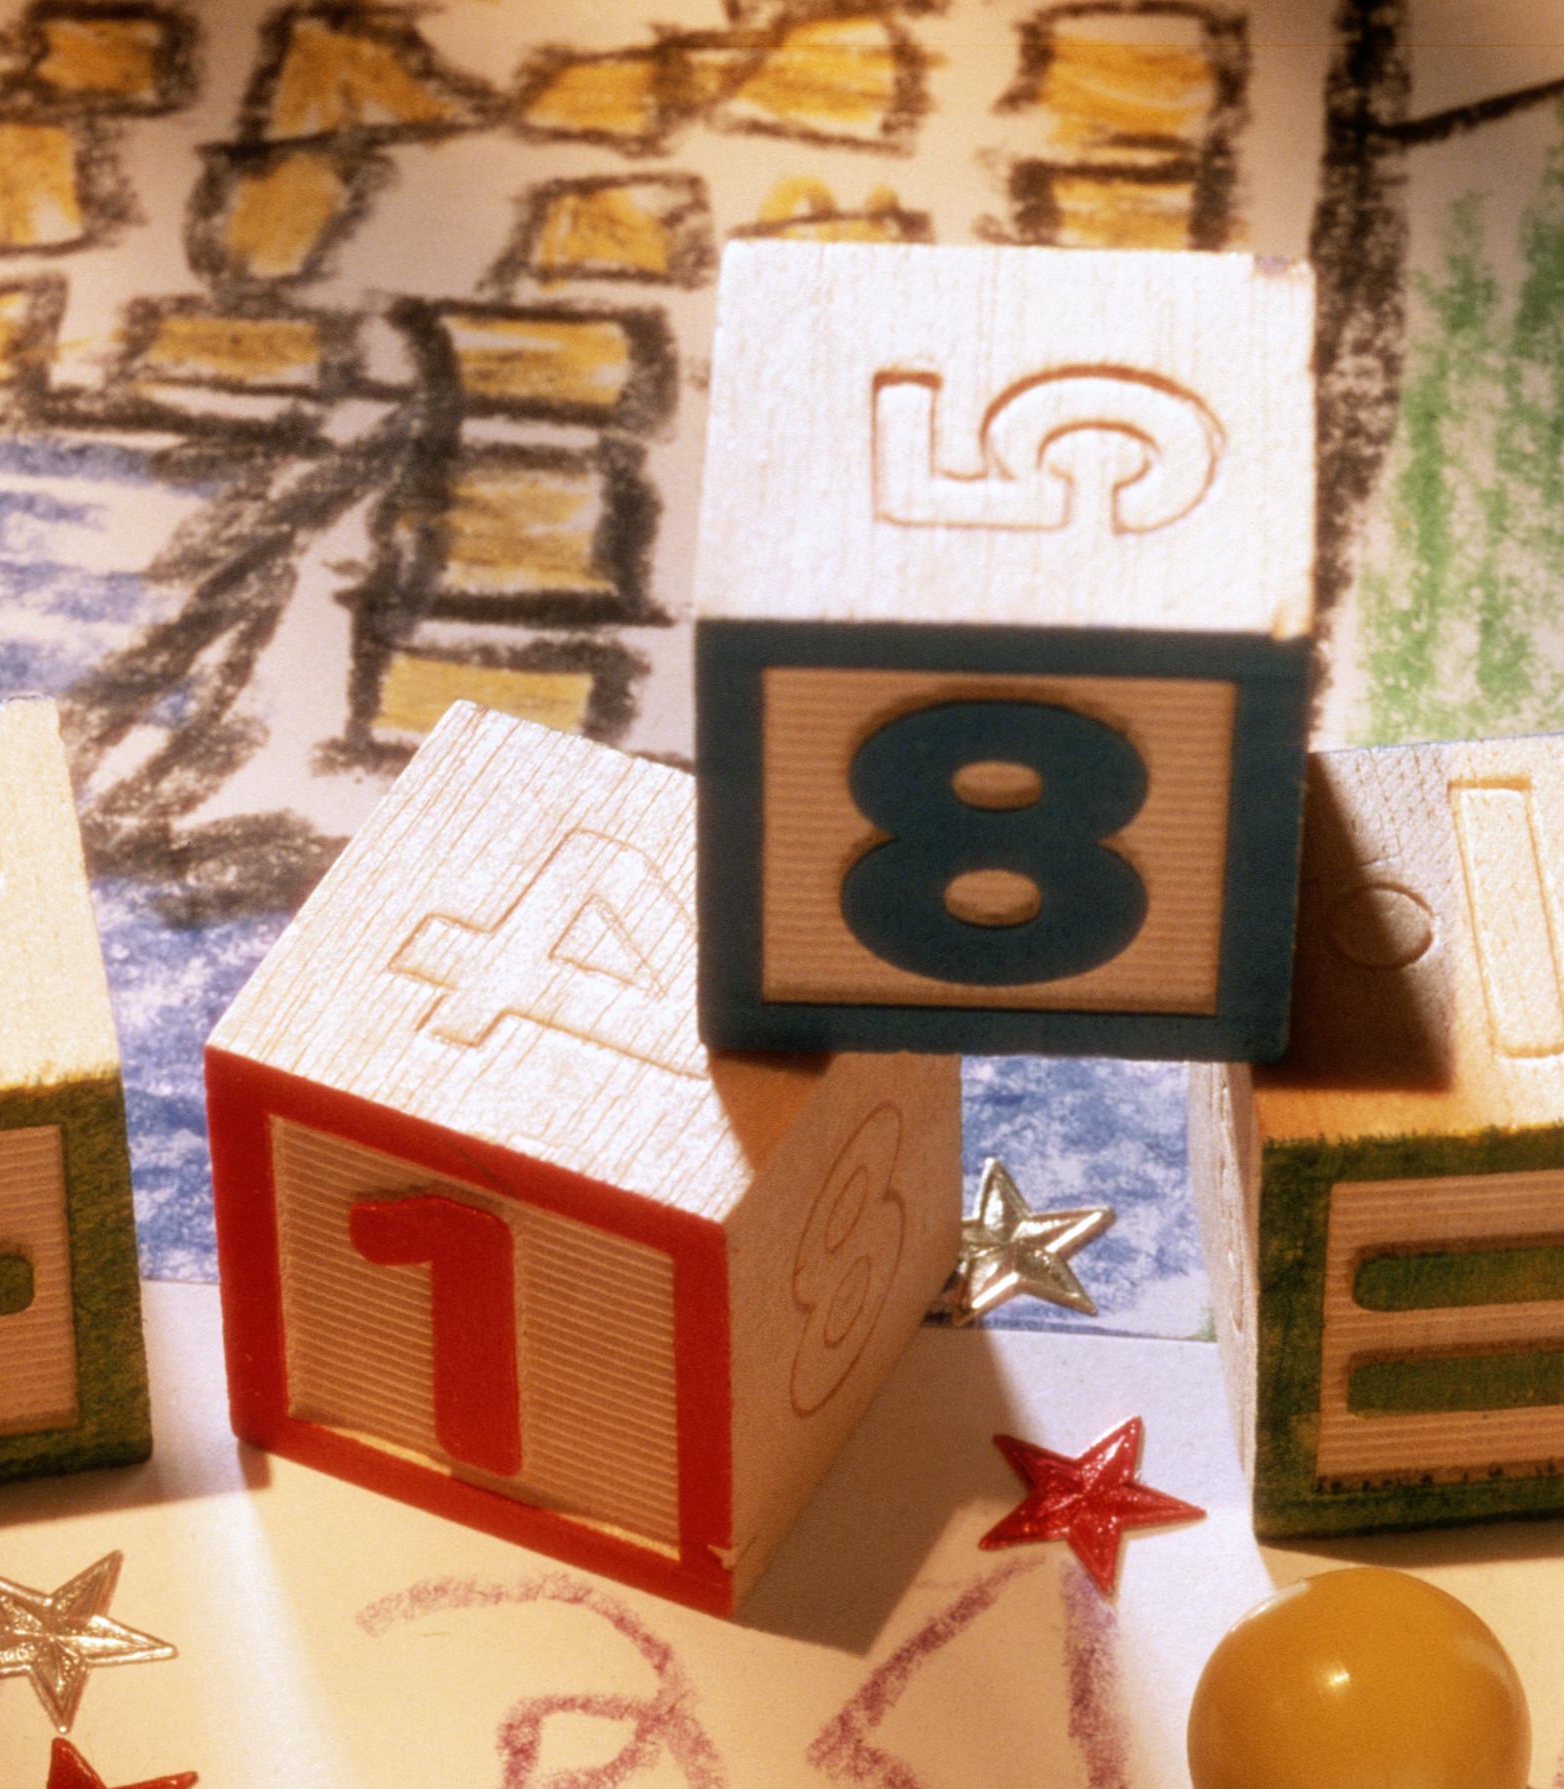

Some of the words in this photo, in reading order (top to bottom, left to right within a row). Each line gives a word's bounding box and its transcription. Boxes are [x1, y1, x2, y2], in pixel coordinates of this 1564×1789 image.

[871, 363, 1227, 536] 5
[385, 828, 709, 1080] 4
[841, 699, 1149, 988] 8
[348, 1197, 523, 1478] 1
